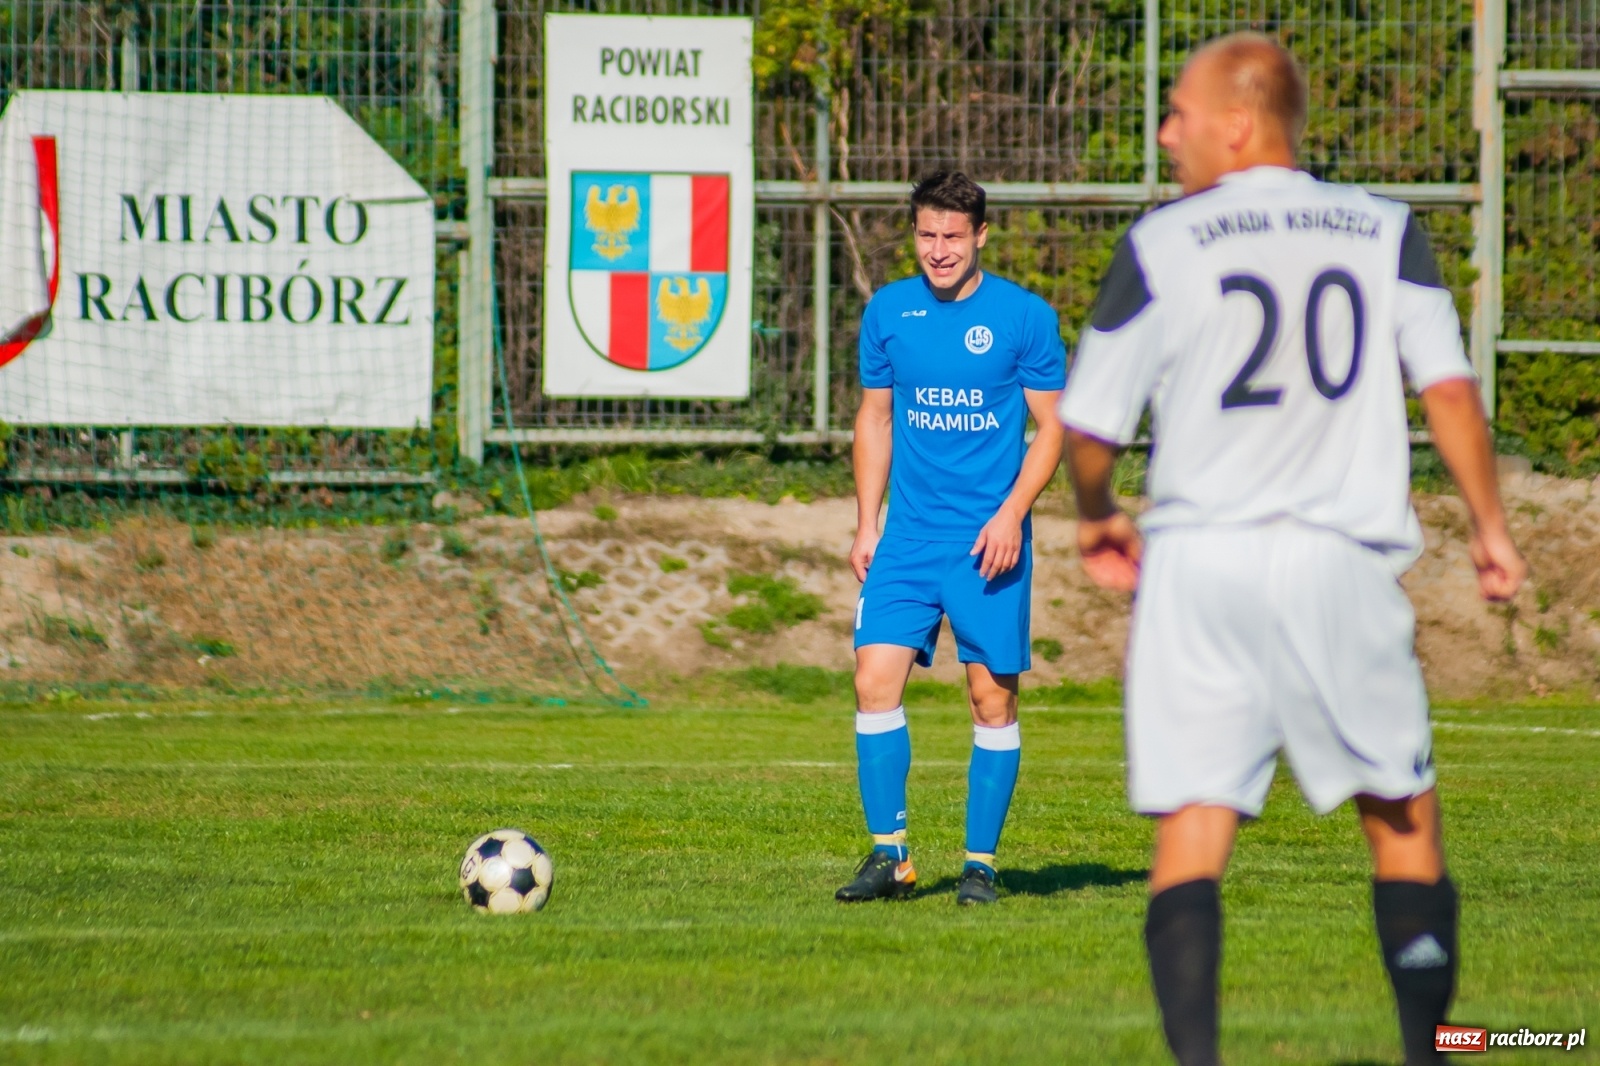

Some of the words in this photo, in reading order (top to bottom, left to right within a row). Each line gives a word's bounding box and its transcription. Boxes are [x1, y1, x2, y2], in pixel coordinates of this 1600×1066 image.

[600, 47, 703, 77] POWIAT
[572, 94, 731, 126] RACIBORSKI
[119, 193, 368, 245] MIASTO
[76, 259, 411, 324] RACIBÓRZ
[1220, 266, 1365, 410] 20
[915, 387, 984, 407] KEBAB
[907, 409, 1000, 432] PIRAMIDA
